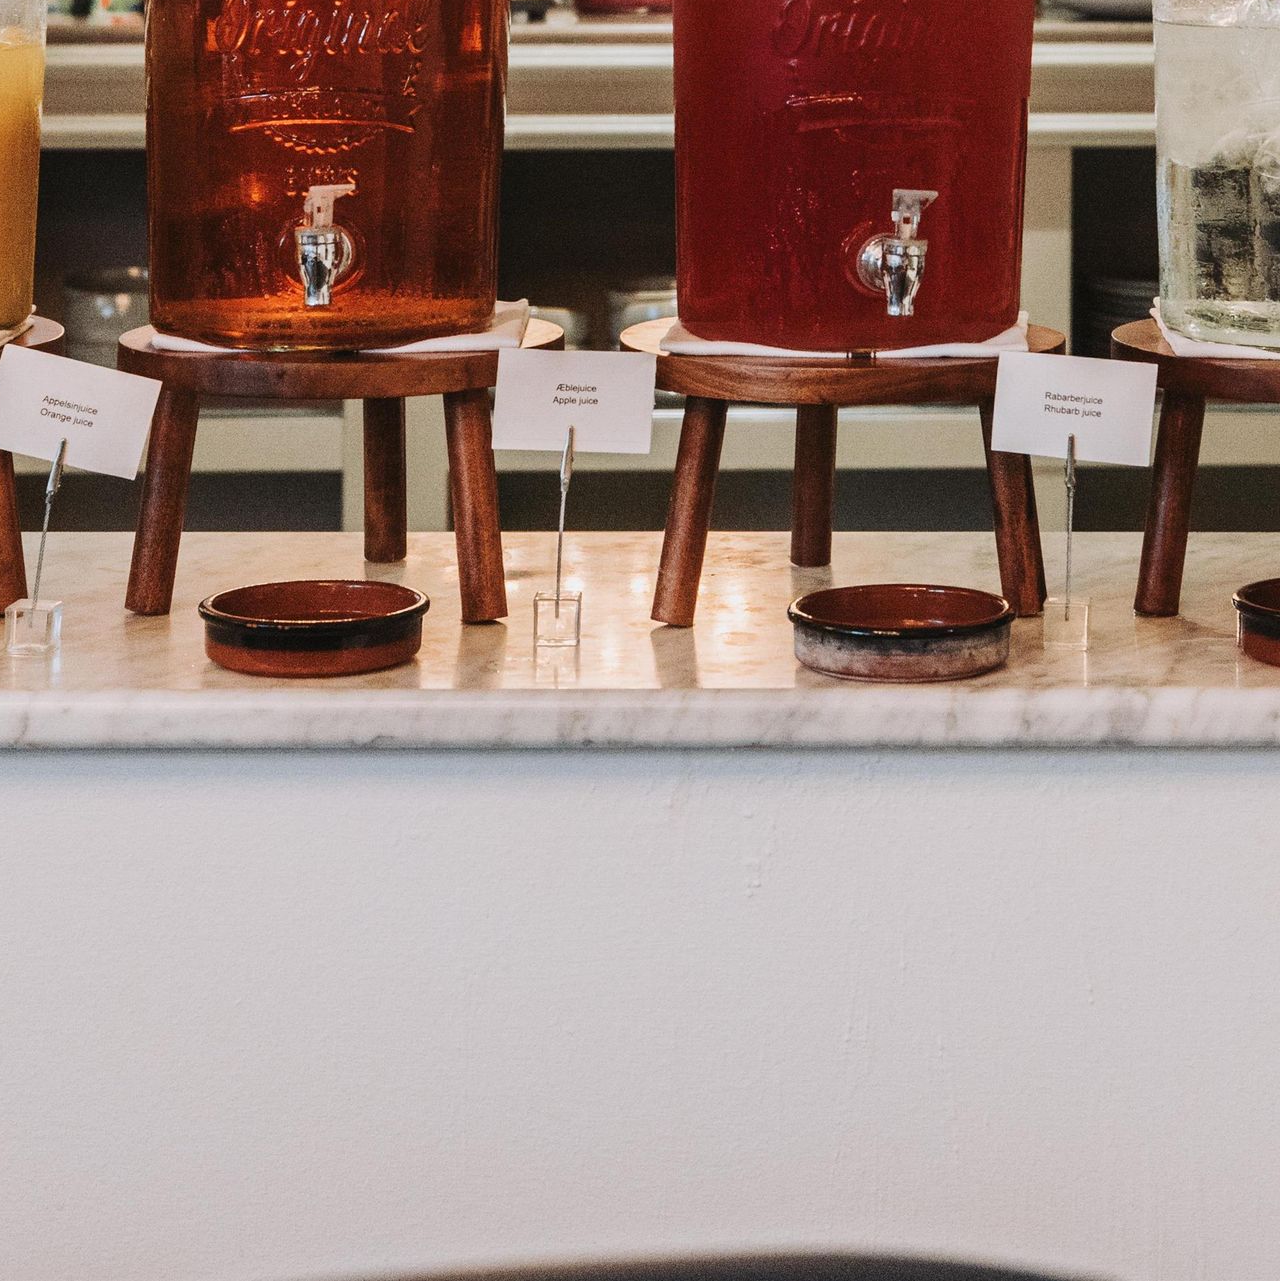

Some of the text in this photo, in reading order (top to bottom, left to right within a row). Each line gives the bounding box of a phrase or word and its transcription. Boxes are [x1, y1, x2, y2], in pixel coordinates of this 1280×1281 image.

[556, 383, 597, 393] Æblejuice
[552, 396, 599, 406] Apple juice
[1045, 392, 1103, 404] Rabarberjuice
[43, 396, 98, 415] Appelsinjuice
[1044, 404, 1102, 418] Rhubarb juice
[40, 408, 94, 427] Orange juice
